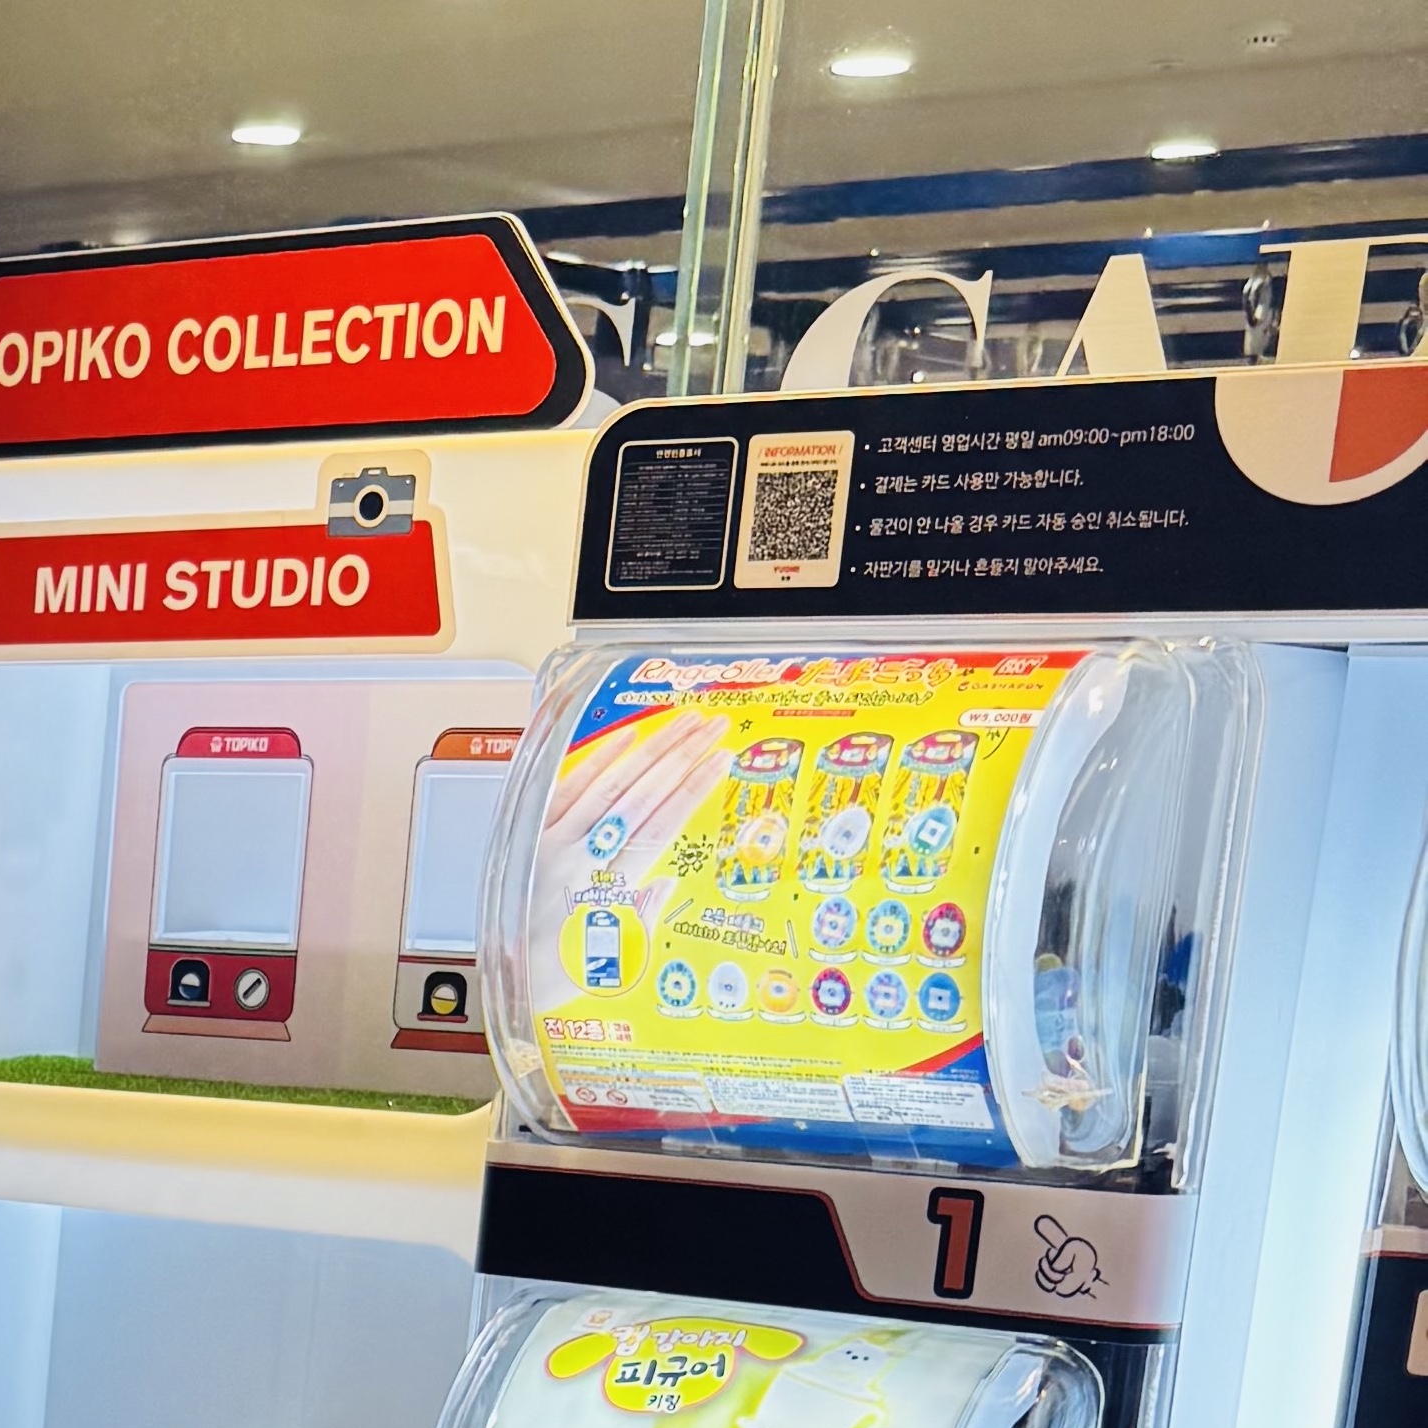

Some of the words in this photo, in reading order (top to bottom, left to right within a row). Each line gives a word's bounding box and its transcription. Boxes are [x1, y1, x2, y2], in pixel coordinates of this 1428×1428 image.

[167, 295, 507, 375] COLLECTION
[878, 434, 938, 454] 고객센터
[941, 431, 1001, 452] 영업시간
[1006, 430, 1035, 449] 평일
[1038, 424, 1196, 448] am09:00~pm18:00
[874, 474, 918, 494] 결제는
[921, 473, 951, 492] 카드
[954, 471, 1000, 490] 사용만
[1003, 469, 1084, 489] 가능합니다.
[869, 516, 913, 536] 물건이
[916, 516, 932, 534] 안
[968, 514, 999, 533] 경우
[1002, 513, 1033, 532] 카드
[1035, 512, 1067, 531] 자동
[1070, 511, 1101, 530] 승인
[1106, 509, 1190, 529] 취소됩니다.
[863, 559, 923, 579] 자판기를
[926, 558, 971, 577] 밀거나
[973, 557, 1019, 577] 흔들지
[1023, 555, 1105, 576] 말아주세요.
[33, 562, 147, 614] MINI
[162, 554, 371, 611] STUDIO
[224, 736, 269, 753] TOPIKO
[926, 1186, 986, 1300] 1
[613, 1352, 727, 1388] 피규어
[646, 1393, 682, 1412] 키링
